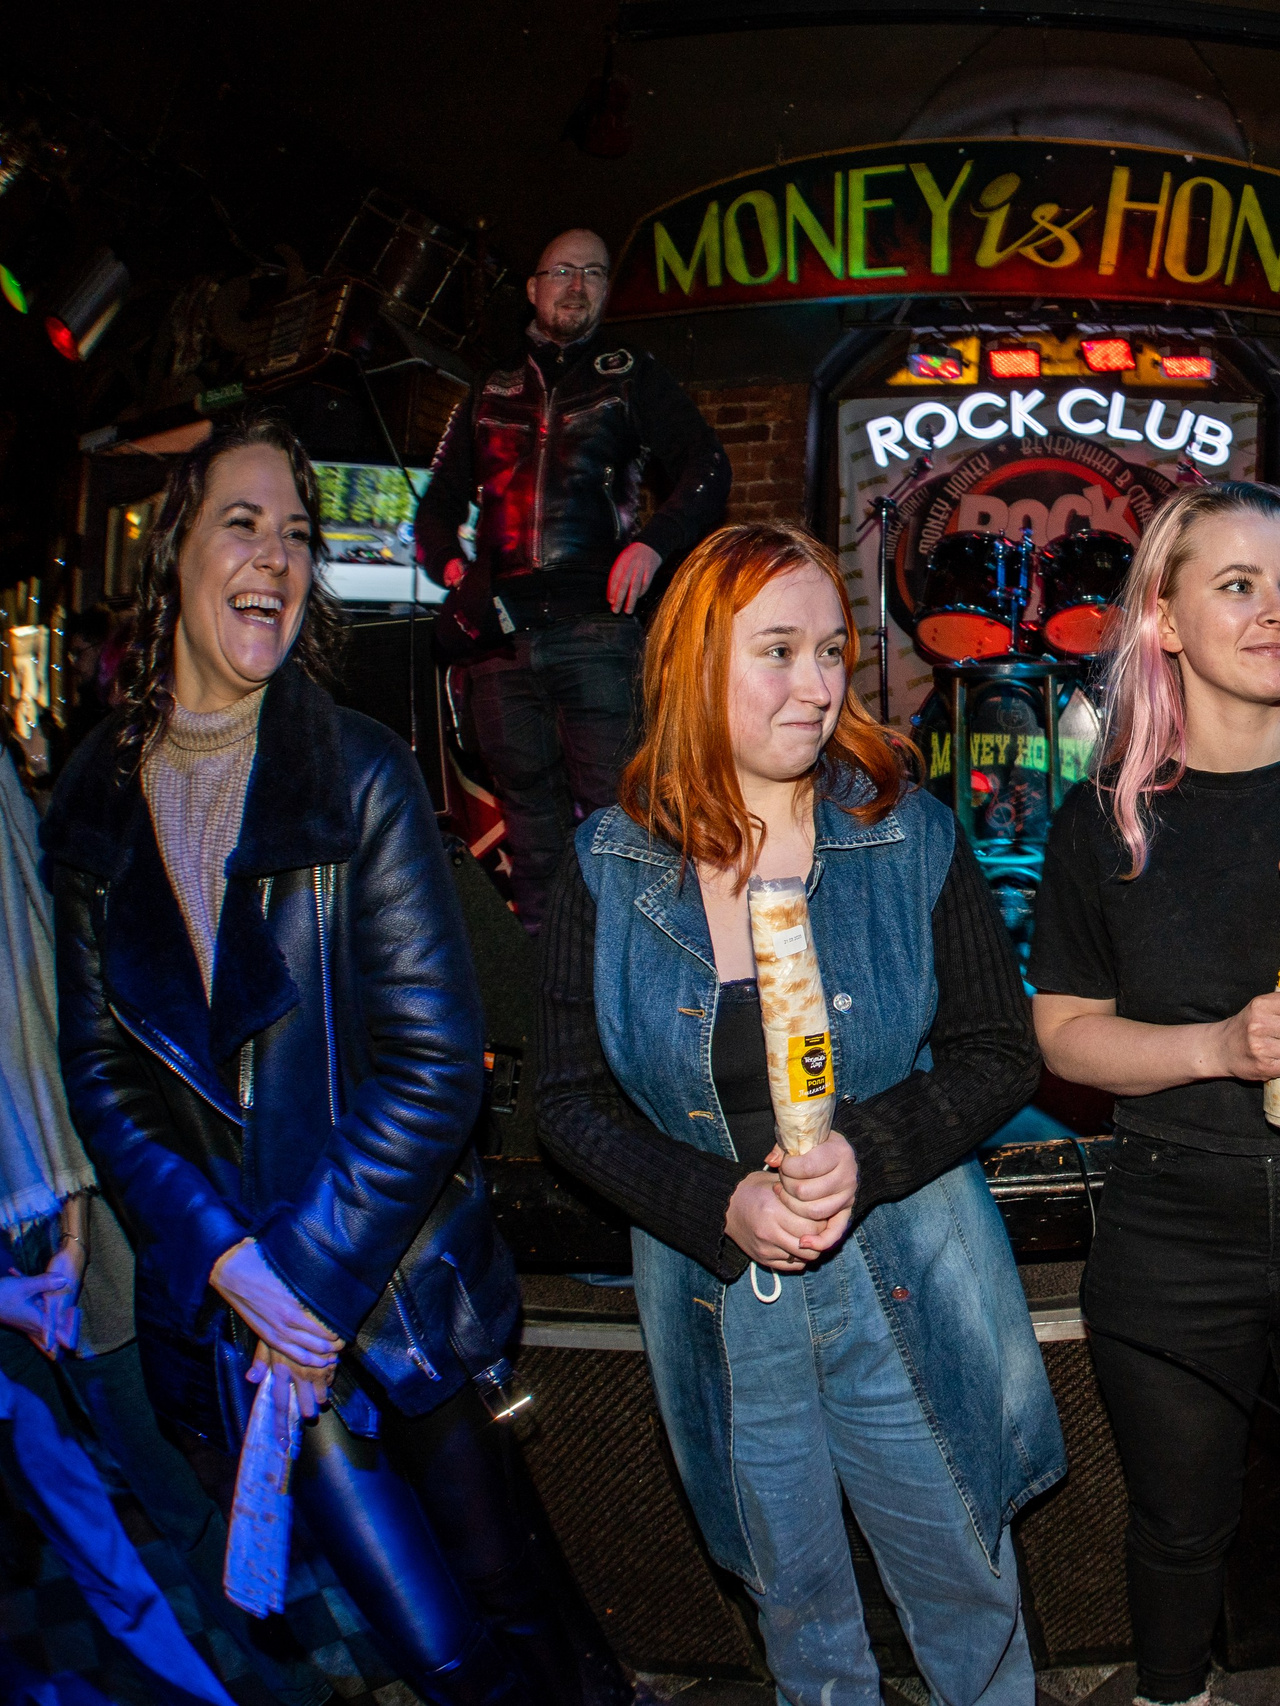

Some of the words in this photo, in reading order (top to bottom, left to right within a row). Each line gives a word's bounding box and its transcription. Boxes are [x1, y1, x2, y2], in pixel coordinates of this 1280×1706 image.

[653, 159, 974, 296] MONEY
[969, 172, 1093, 269] is
[865, 389, 1049, 468] ROCK
[1057, 388, 1234, 466] CLUB
[943, 452, 991, 500] HONEY
[930, 732, 1011, 779] MNEY
[1014, 735, 1094, 784] HOEY
[808, 1078, 826, 1087] РОЛЛ
